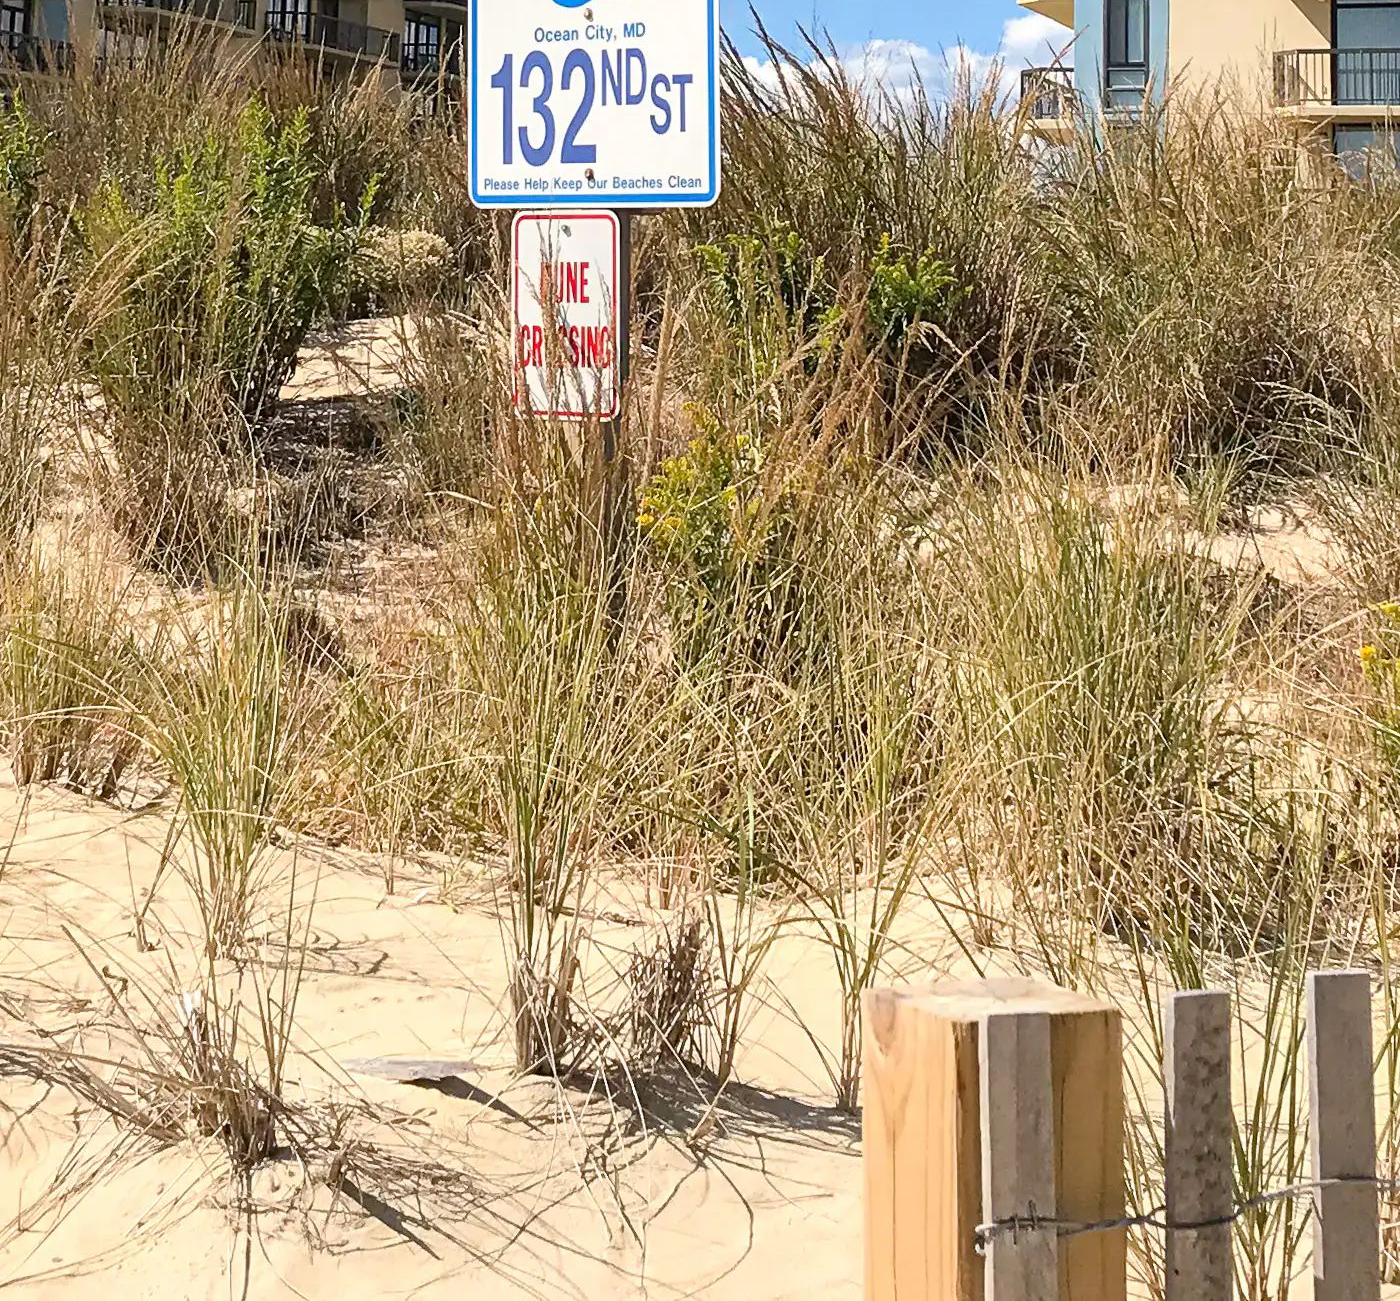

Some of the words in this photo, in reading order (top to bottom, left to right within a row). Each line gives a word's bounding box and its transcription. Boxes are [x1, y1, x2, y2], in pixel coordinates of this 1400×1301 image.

[534, 27, 579, 43] Ocean
[585, 24, 617, 42] City,
[623, 22, 646, 38] MD
[484, 178, 519, 190] Please
[524, 178, 549, 192] Help
[553, 177, 583, 192] Keep
[587, 177, 607, 189] Our
[612, 176, 663, 189] Beaches
[668, 175, 702, 188] Clean
[540, 262, 589, 303] UNE
